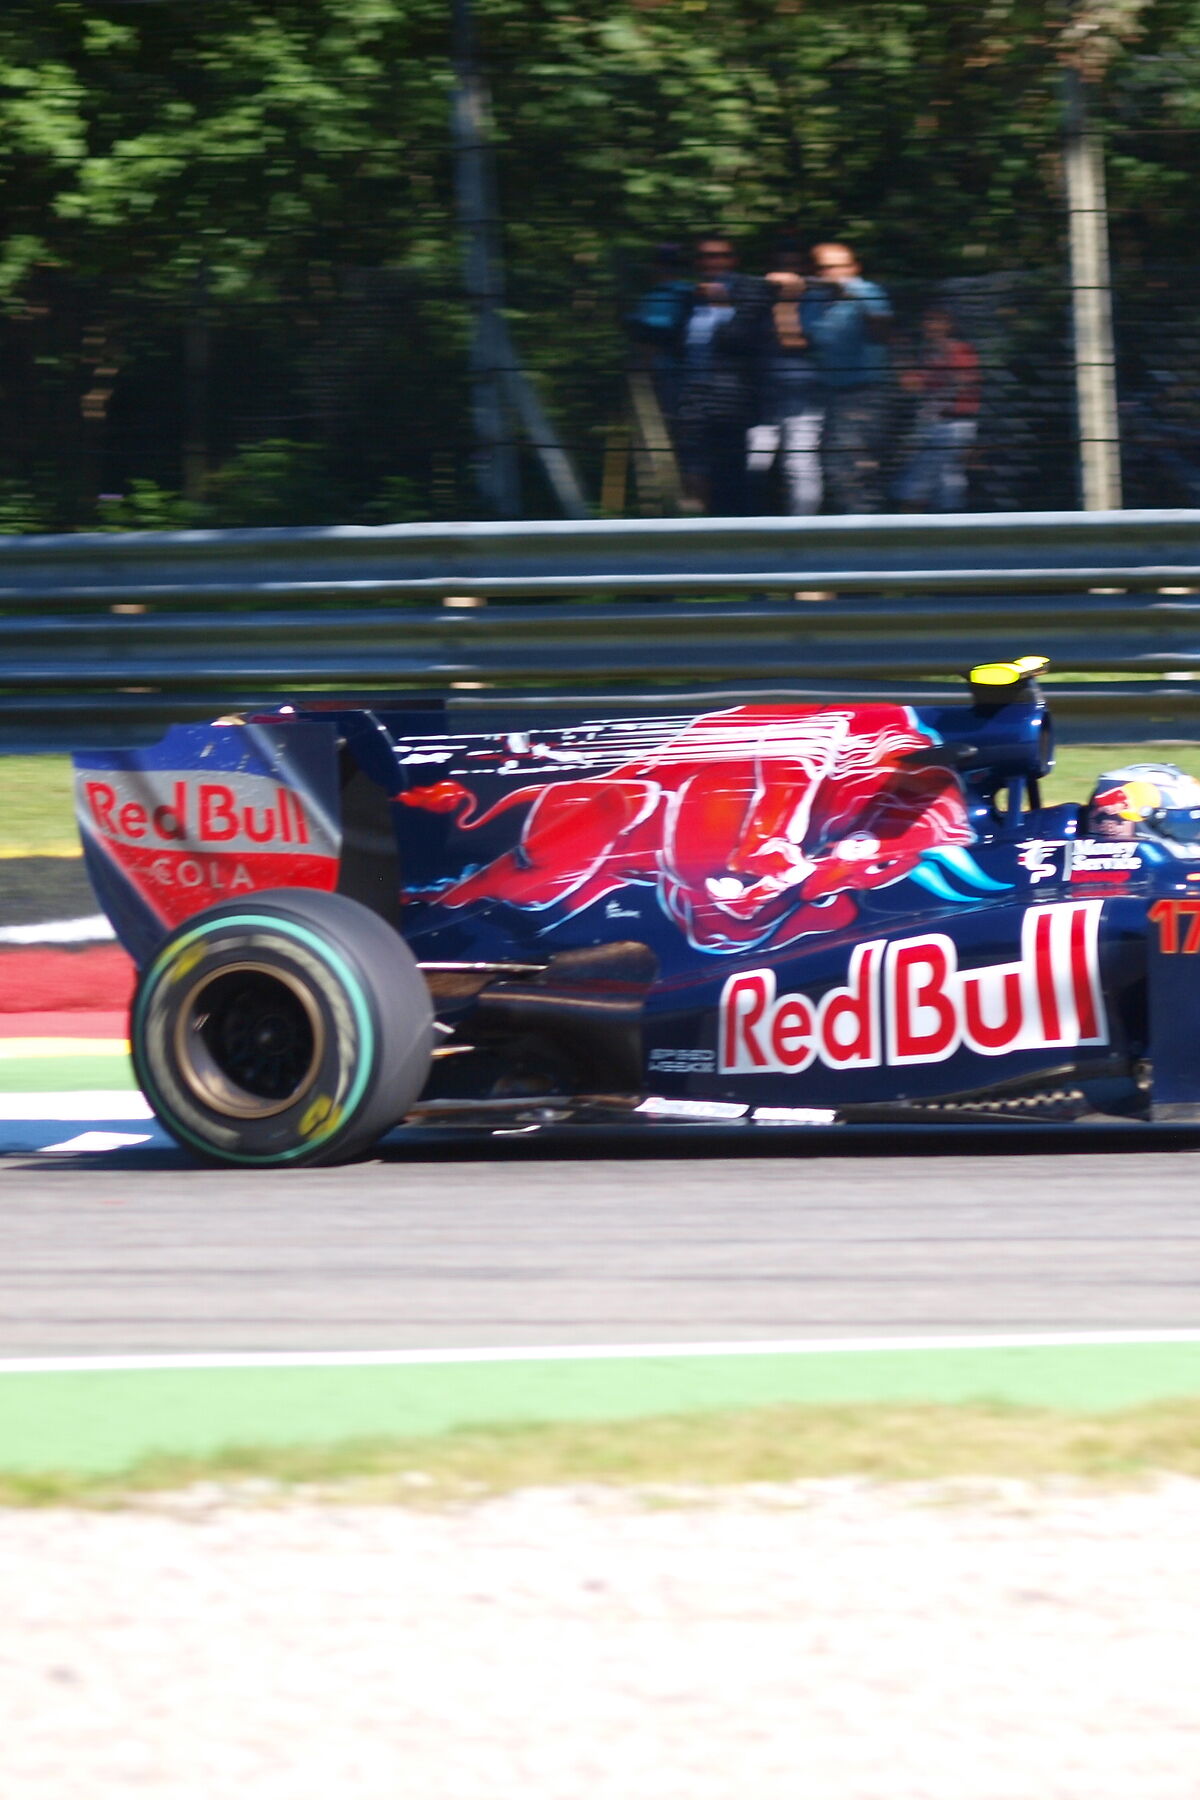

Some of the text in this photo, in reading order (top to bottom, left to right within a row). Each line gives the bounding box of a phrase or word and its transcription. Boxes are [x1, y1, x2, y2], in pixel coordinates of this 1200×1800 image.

[84, 780, 310, 844] Red Bull
[152, 857, 255, 889] COLA
[722, 905, 1100, 1070] Red Bull
